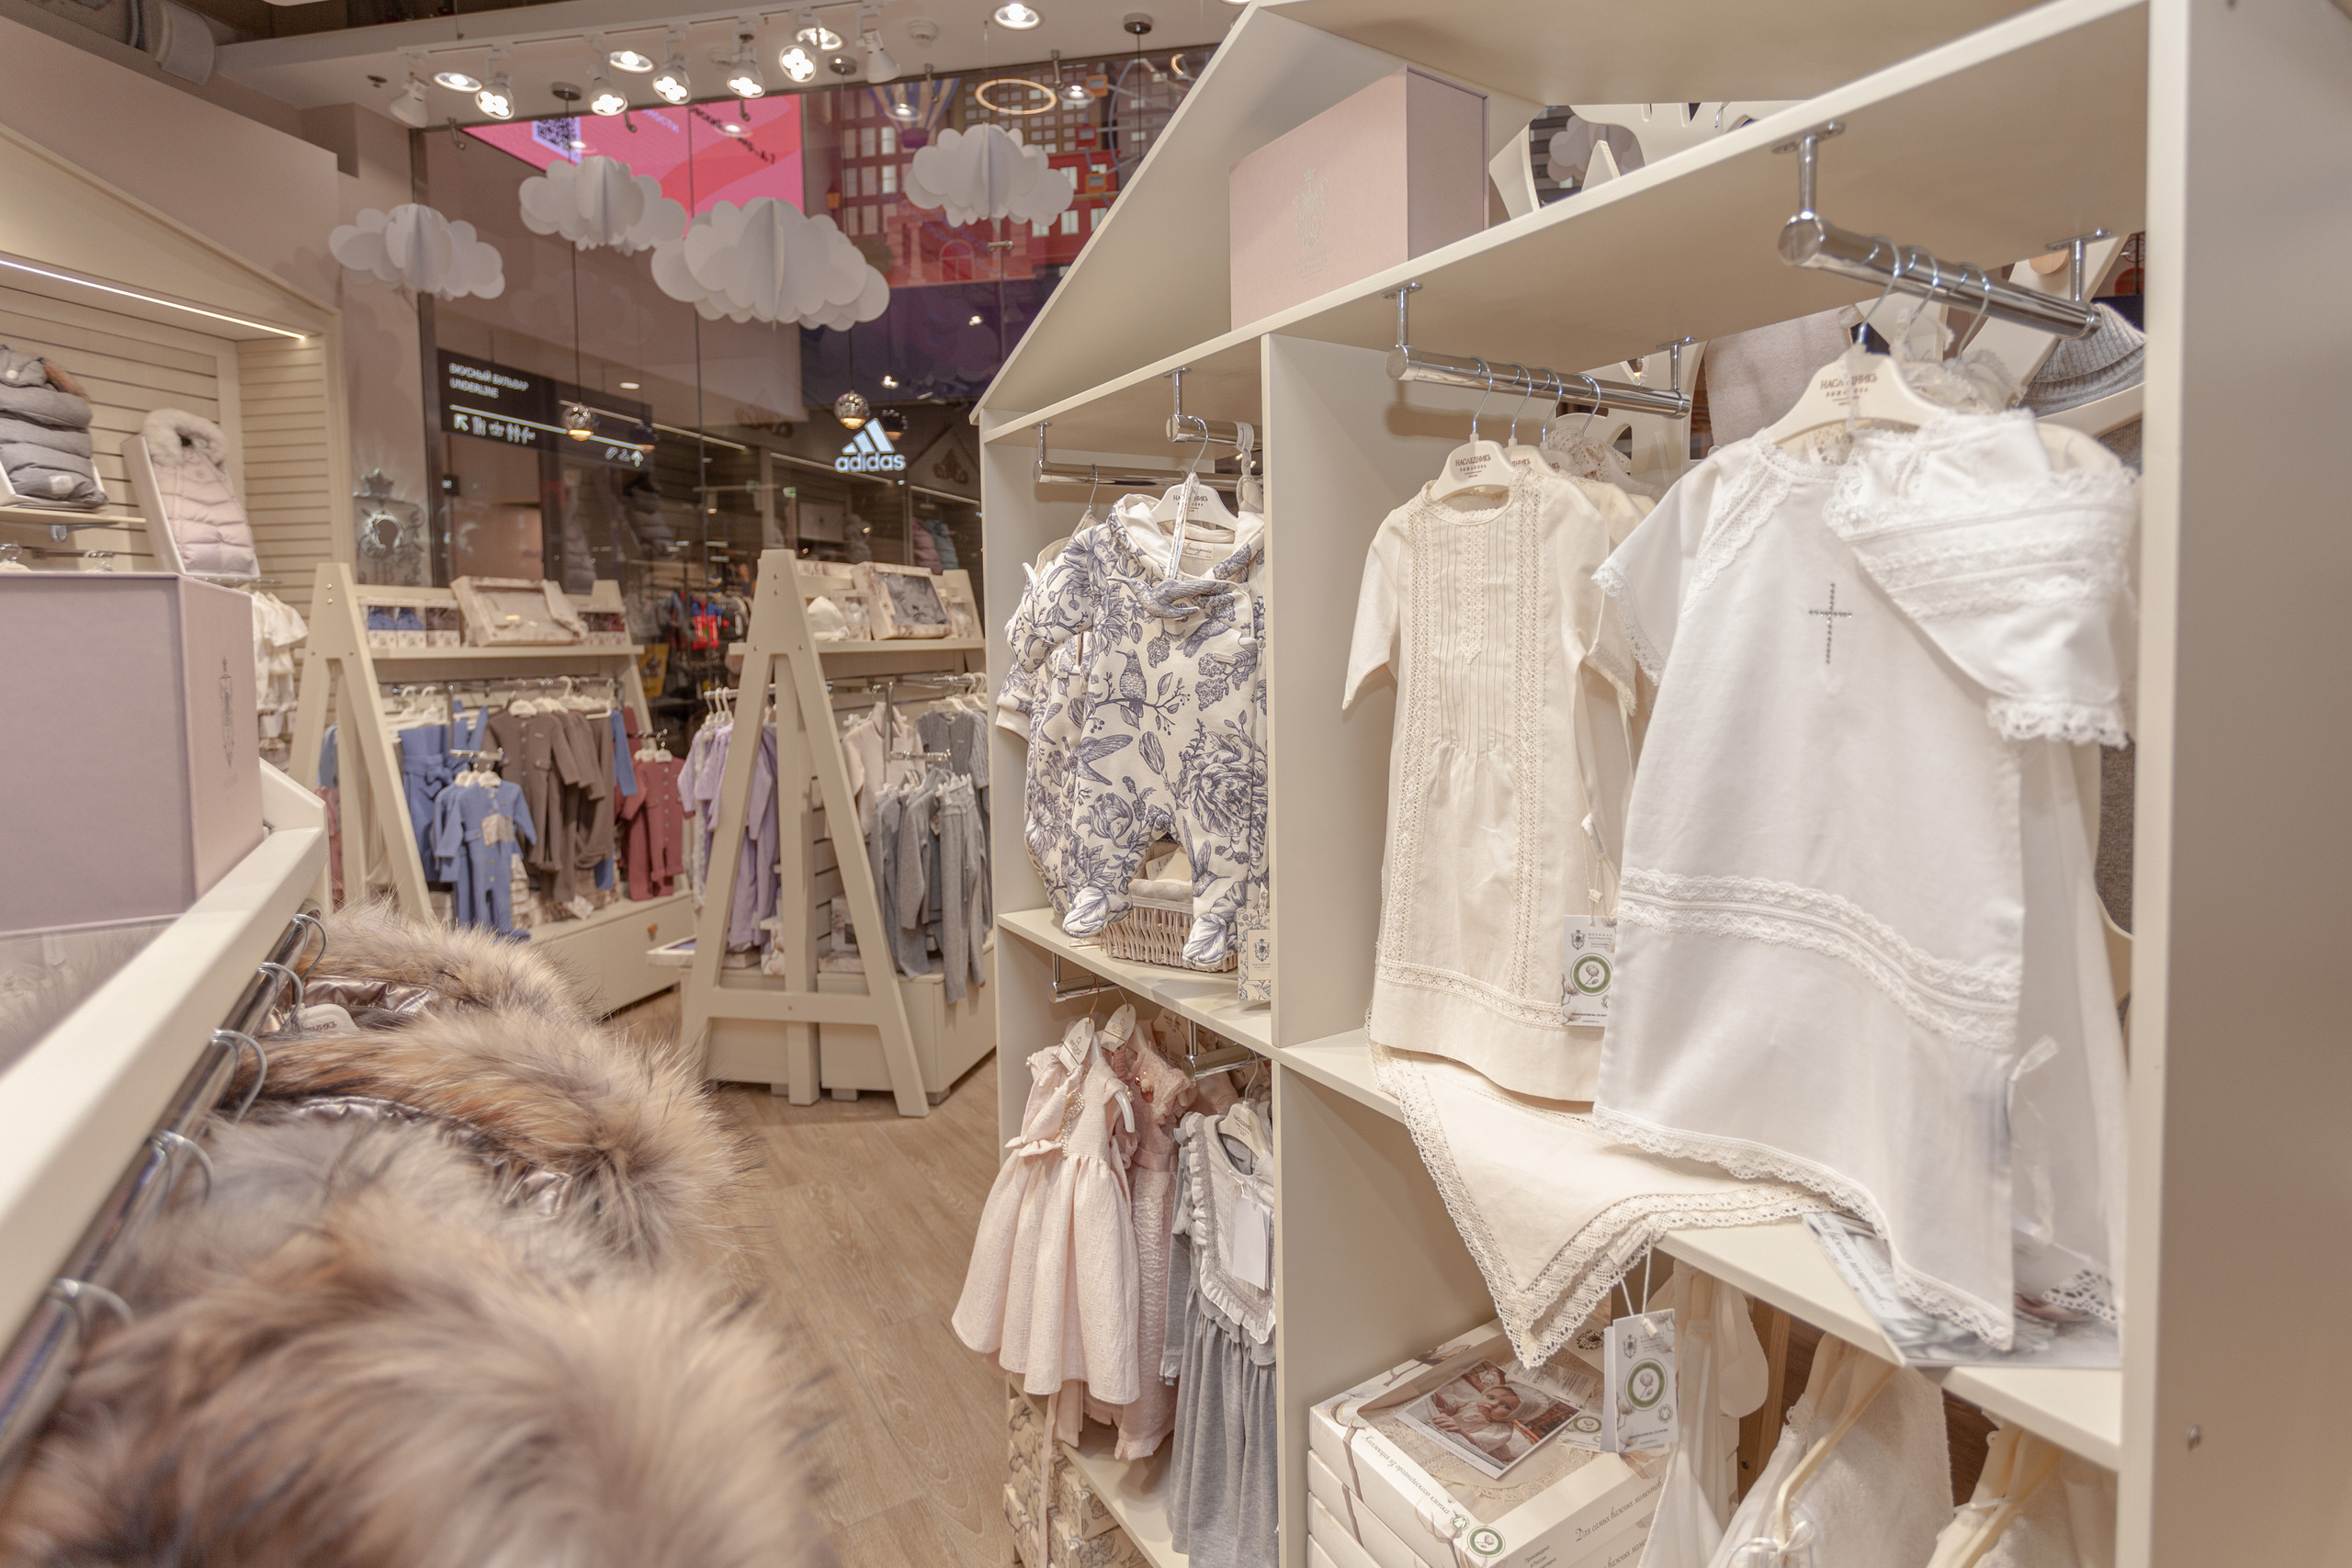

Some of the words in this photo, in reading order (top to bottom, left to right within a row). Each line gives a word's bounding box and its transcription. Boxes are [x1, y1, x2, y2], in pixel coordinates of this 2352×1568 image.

[449, 363, 492, 382] ВКУСНЫЙ
[492, 374, 529, 392] БУЛЬВАР
[449, 377, 499, 399] UNDERLINE
[1820, 373, 1878, 389] НАСЛДНИКЪ
[835, 452, 906, 473] adidas
[1361, 1435, 1390, 1461] Коллекция
[1395, 1464, 1430, 1496] органического
[1430, 1495, 1450, 1515] хлопка
[1575, 1526, 1591, 1542] Для
[1591, 1515, 1611, 1532] самых
[1611, 1506, 1634, 1519] важных
